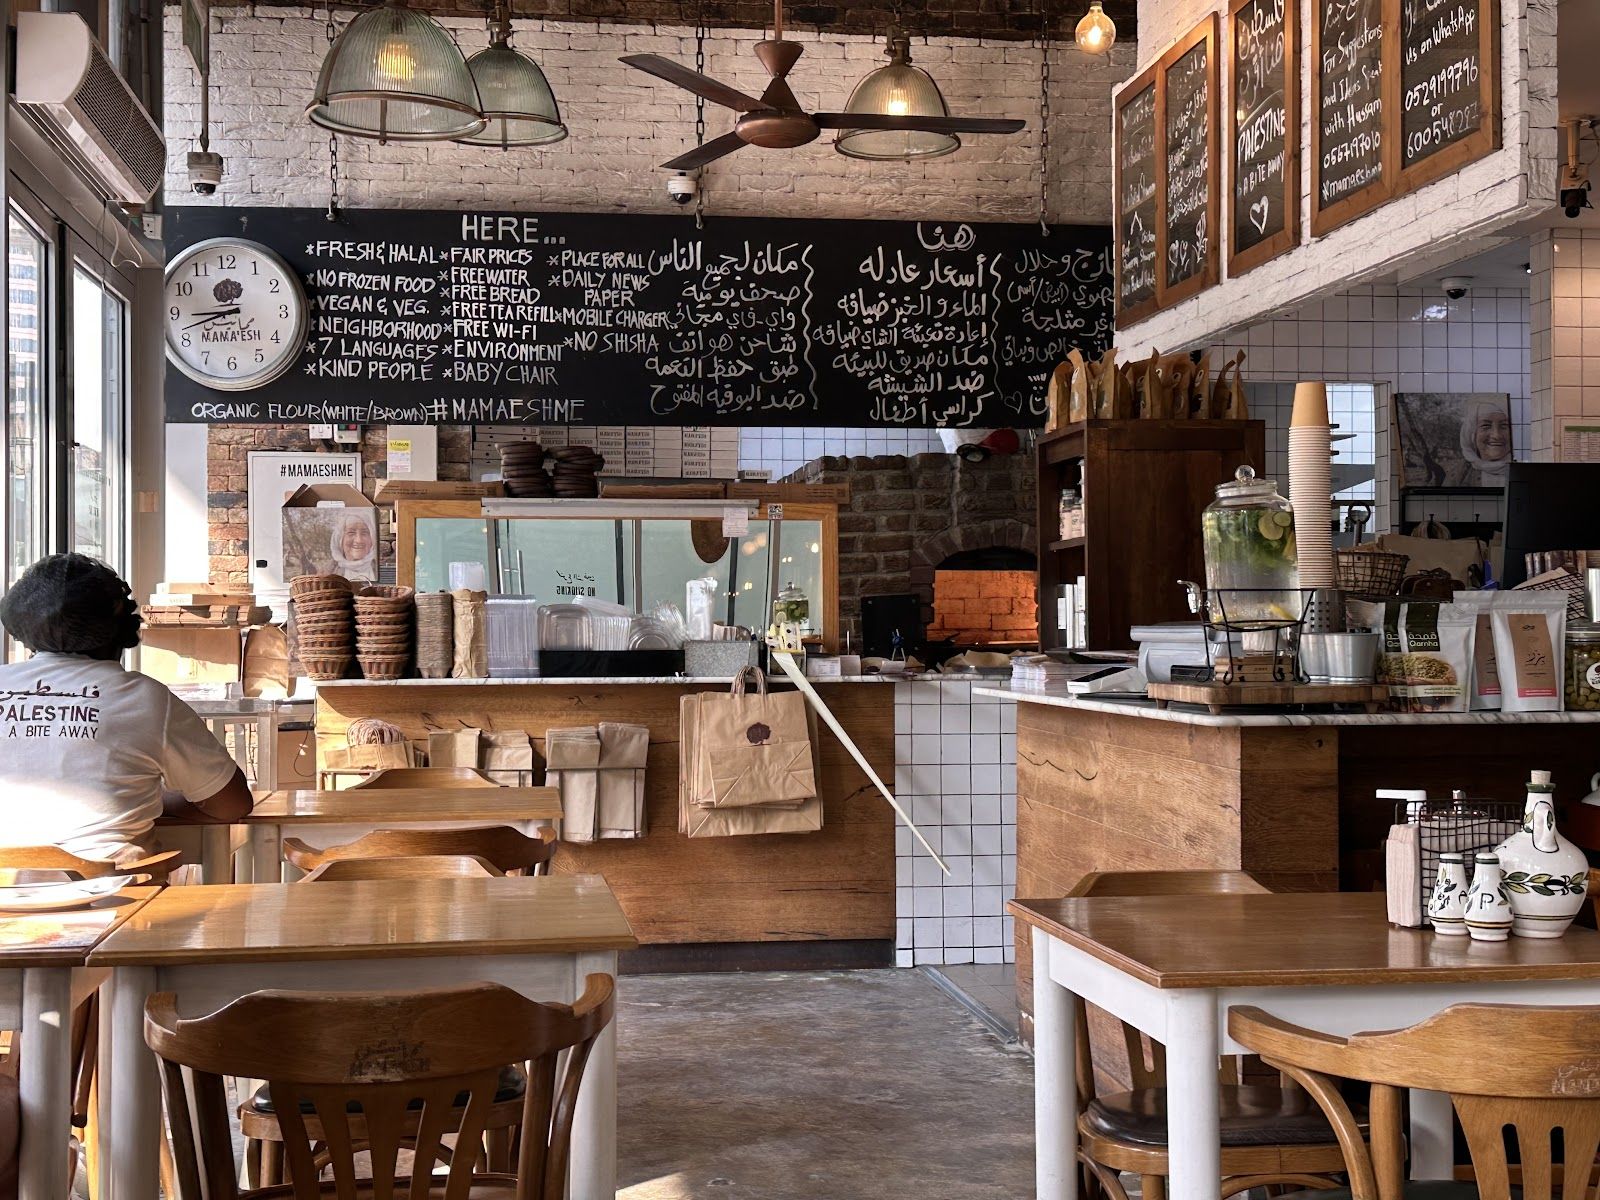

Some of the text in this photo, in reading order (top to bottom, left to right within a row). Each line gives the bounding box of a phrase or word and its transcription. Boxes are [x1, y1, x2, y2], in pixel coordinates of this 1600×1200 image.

[1406, 46, 1417, 65] Us
[1421, 38, 1431, 54] on
[1433, 5, 1475, 46] WhatsApp
[1323, 49, 1336, 73] For
[1338, 17, 1382, 71] Suggestions
[1405, 56, 1478, 111] 0529199796
[1323, 82, 1337, 108] and
[1325, 98, 1382, 136] with Hussam
[1431, 103, 1443, 117] or
[1238, 108, 1286, 163] PALESTINE
[1243, 182, 1250, 196] A
[917, 221, 976, 252] هنا
[217, 255, 236, 270] 12
[389, 243, 439, 265] HALAL
[450, 248, 533, 265] FAIR PRICES
[561, 250, 645, 269] PLACE FOR ALL
[648, 237, 799, 290] مكان لجميع الناس
[192, 262, 210, 276] 11
[251, 261, 259, 275] 1
[450, 267, 531, 287] FREE WATER
[921, 253, 987, 291] أسعار
[175, 282, 193, 296] 10
[269, 279, 280, 294] 2
[316, 268, 436, 294] NO FROZEN FOOD
[563, 269, 650, 291] DAILY NEWS
[451, 284, 540, 304] FREE BREAD
[584, 290, 635, 308] PAPER
[170, 306, 180, 320] 9
[279, 305, 289, 319] 3
[318, 295, 372, 313] VEGAN
[452, 302, 556, 323] FREE TEA REFILL
[563, 307, 669, 330] MOBILE CHARGER
[202, 330, 261, 342] MAMA'ESH
[271, 330, 280, 344] 4
[318, 317, 443, 341] NEIGHBORHOOD
[453, 319, 537, 341] FREE WI-FI
[181, 333, 191, 347] 8
[320, 337, 438, 362] 7 LANGUAGES
[574, 331, 659, 353] NO SHISHA
[201, 351, 210, 365] 7
[254, 349, 264, 363] 5
[454, 340, 564, 361] ENVIRONMENT
[227, 357, 237, 370] 6
[319, 359, 433, 381] KIND PEOPLE
[454, 361, 559, 386] BABY CHAIR
[191, 402, 260, 420] ORGANIC
[280, 464, 353, 477] #MAMAESHME
[8, 725, 98, 740] A BITE AWAY
[1480, 893, 1495, 910] P
